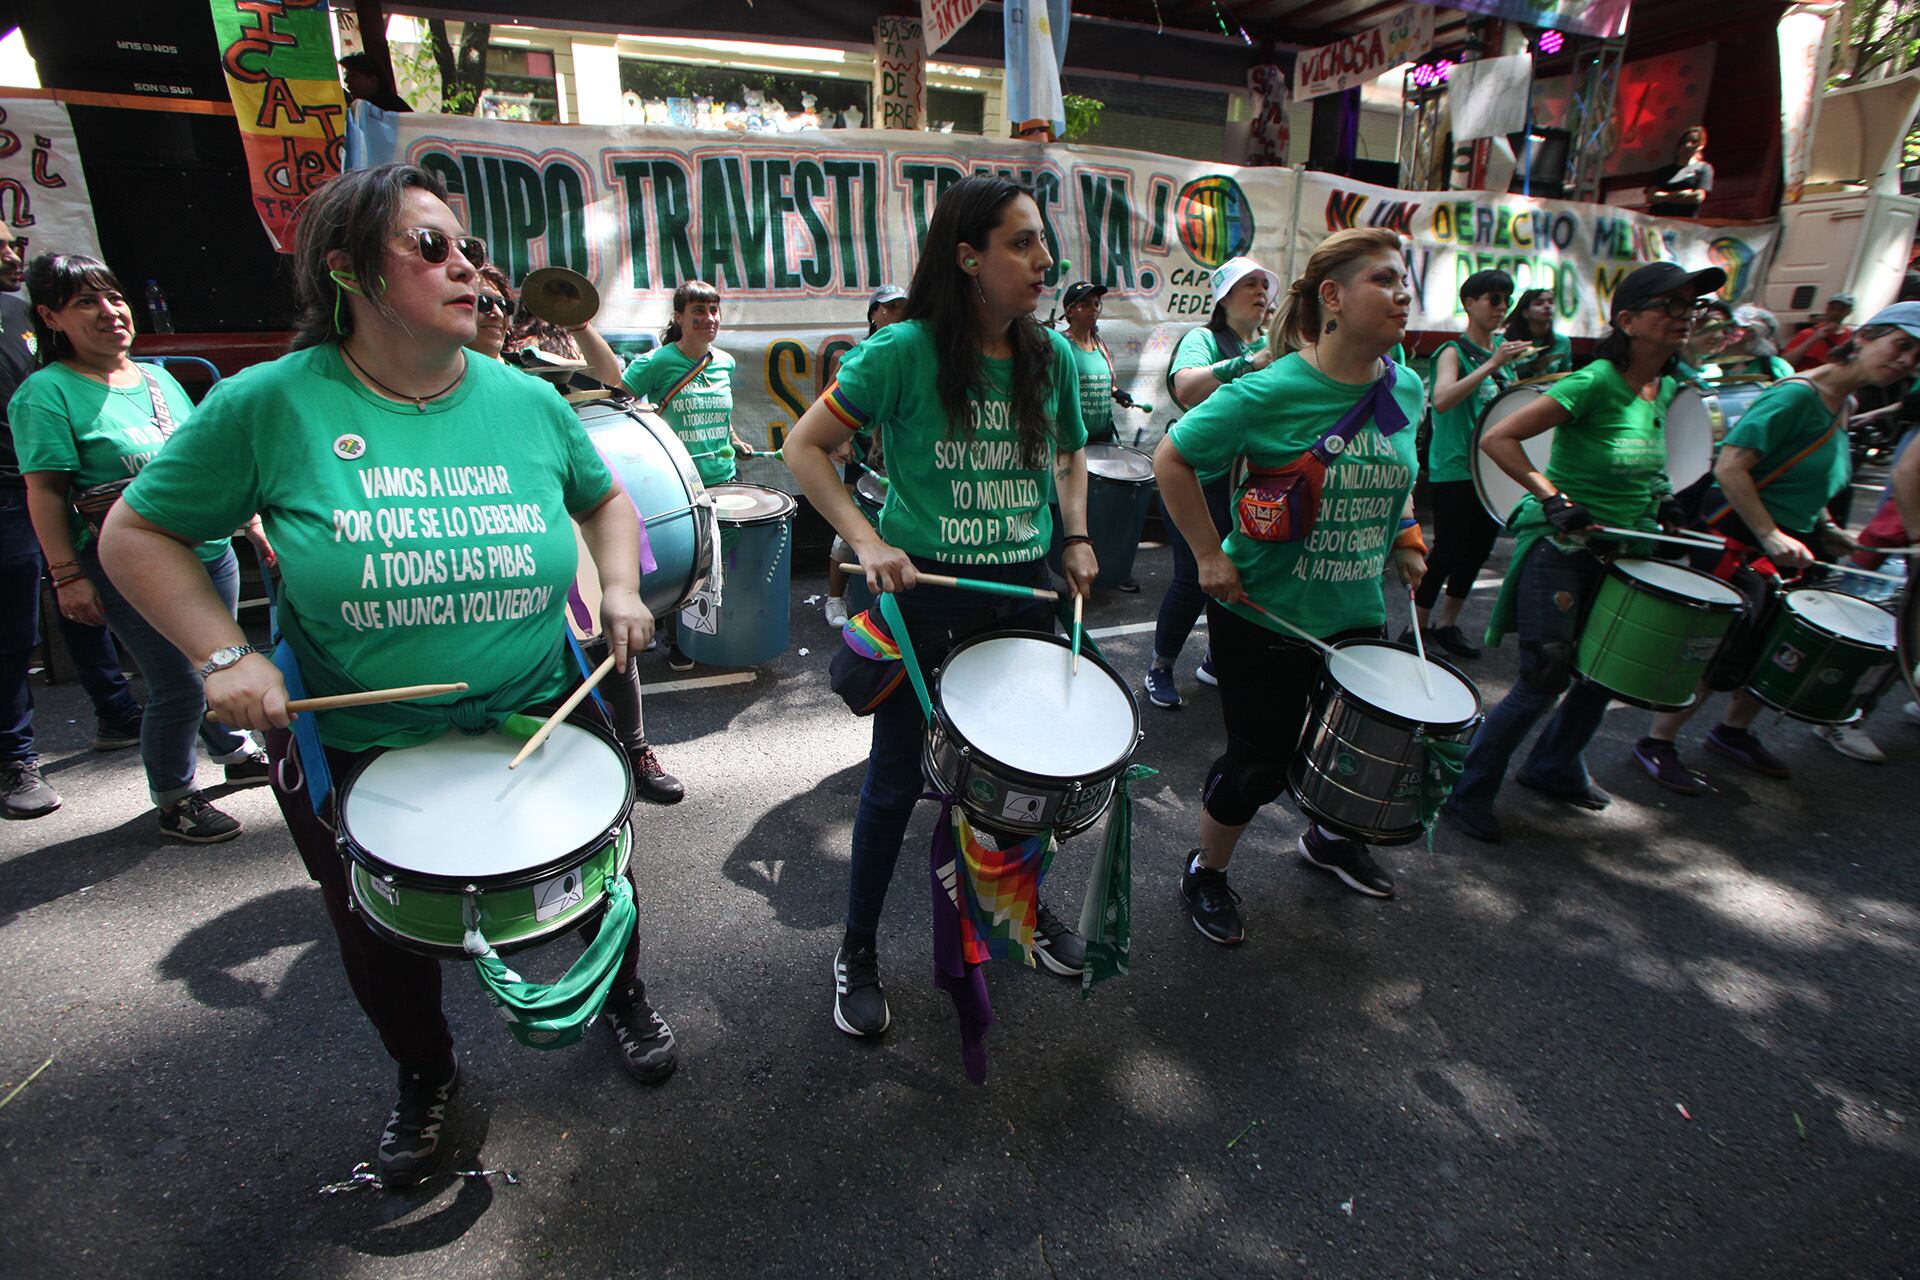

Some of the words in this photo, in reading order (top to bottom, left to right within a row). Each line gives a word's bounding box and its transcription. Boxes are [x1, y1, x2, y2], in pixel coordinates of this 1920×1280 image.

[133, 82, 159, 92] SON
[169, 85, 193, 95] SUR
[883, 71, 908, 99] DE
[883, 101, 914, 129] PRE
[611, 156, 885, 291] TRAVESTI
[1325, 188, 1369, 233] NI
[1170, 268, 1212, 288] CAP
[672, 399, 685, 413] POR
[984, 400, 1012, 431] SOY
[935, 440, 967, 471] SOY
[358, 465, 427, 499] VAMOS
[431, 467, 445, 498] A
[447, 465, 513, 497] LUCHAR
[951, 479, 973, 510] YO
[976, 478, 1041, 511] MOVILIZO,
[1334, 496, 1349, 522] EL
[1350, 496, 1394, 522] ESTADO
[332, 507, 374, 544] POR
[377, 507, 418, 549] QUE
[421, 508, 440, 539] SE
[441, 506, 468, 538] LO
[472, 503, 547, 536] DEBEMOS
[938, 515, 983, 546] TOCO
[986, 518, 1001, 545] EL
[1320, 529, 1349, 554] DOY
[1349, 525, 1388, 553] GUERRA
[361, 554, 379, 590] A
[381, 549, 449, 589] TODAS
[451, 547, 486, 582] LAS
[488, 544, 537, 579] PIBAS
[1292, 555, 1308, 581] AL
[341, 599, 384, 633] QUE
[386, 594, 457, 629] NUNCA
[459, 585, 554, 624] VOLVIERON
